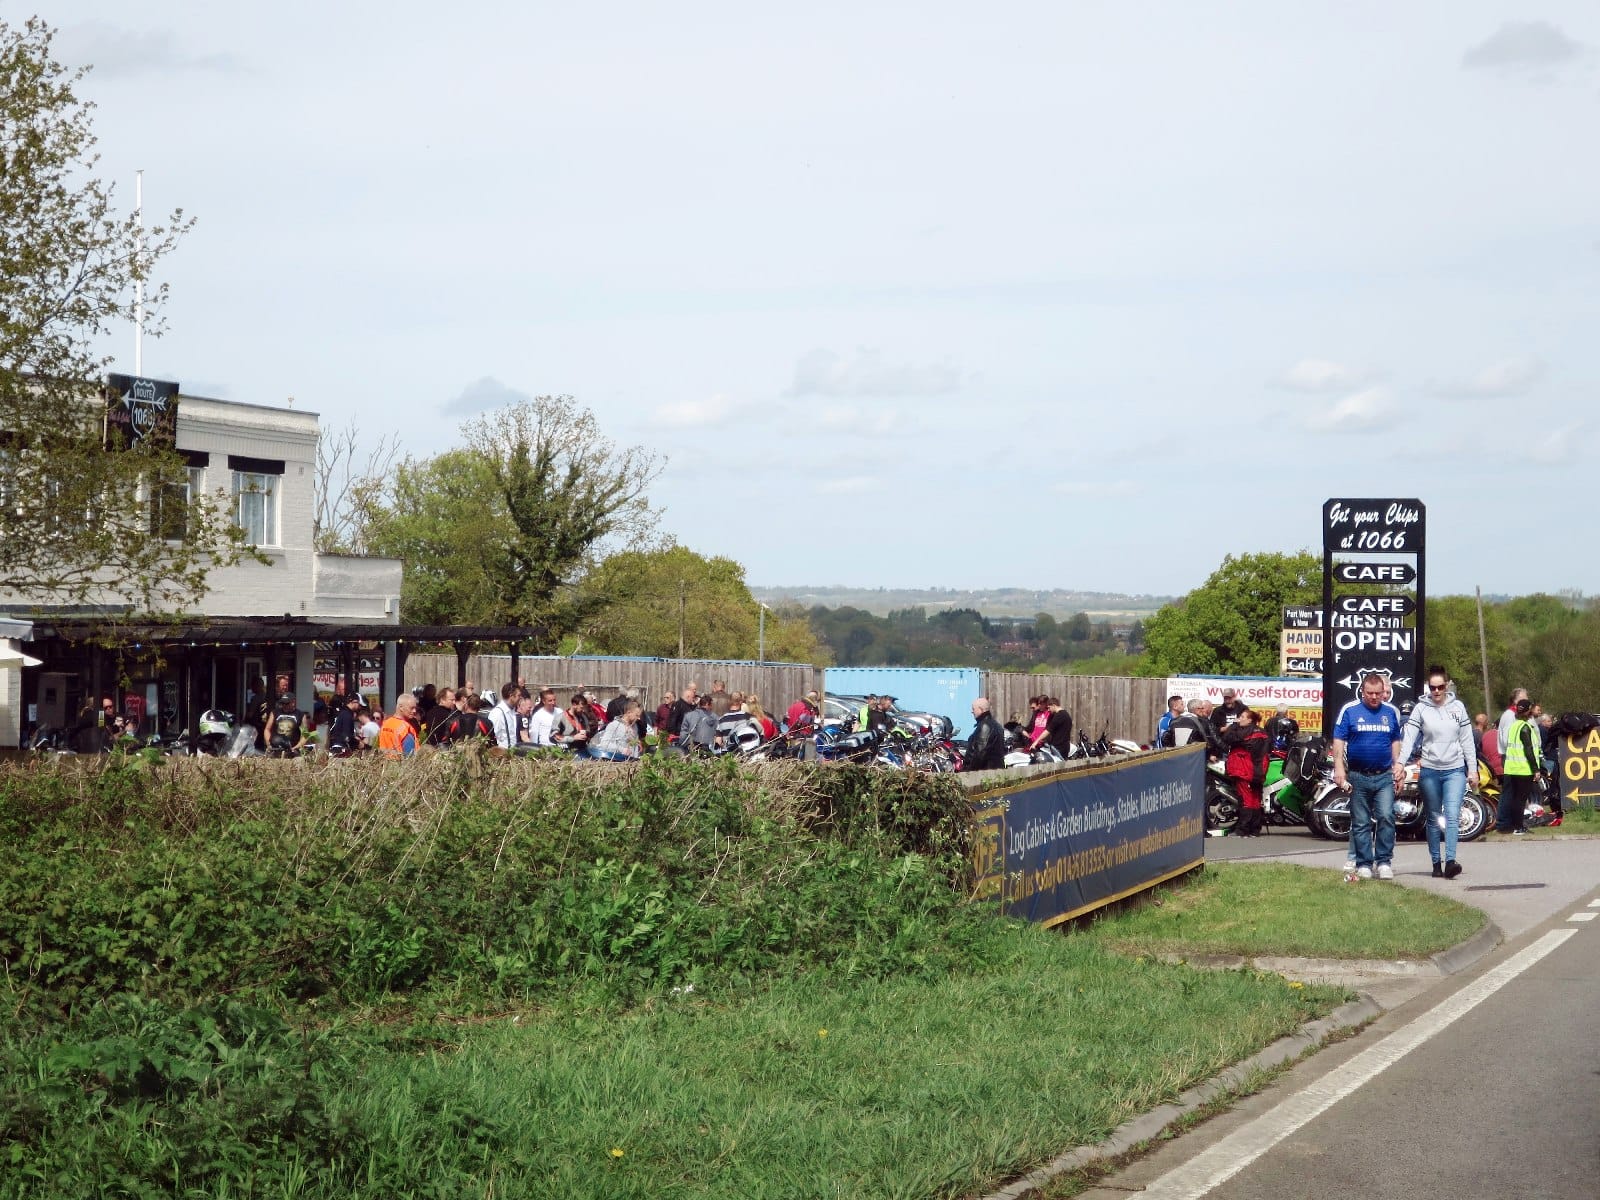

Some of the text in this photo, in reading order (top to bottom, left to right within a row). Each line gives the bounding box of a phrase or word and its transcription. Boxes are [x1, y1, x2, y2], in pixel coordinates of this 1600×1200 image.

[136, 388, 153, 399] ROUTE
[1330, 503, 1419, 528] Get your Chips
[1341, 531, 1407, 549] at 1066
[1342, 566, 1404, 580] CAFE
[1342, 598, 1404, 612] CAFE
[1286, 633, 1322, 645] HAND
[1335, 631, 1411, 651] OPEN
[1303, 647, 1322, 655] OPEN
[1357, 724, 1391, 733] SAMSUNG
[1009, 827, 1026, 860] Log
[1026, 818, 1051, 850] Cabins
[1050, 813, 1057, 840] &
[1056, 807, 1083, 839] Garden
